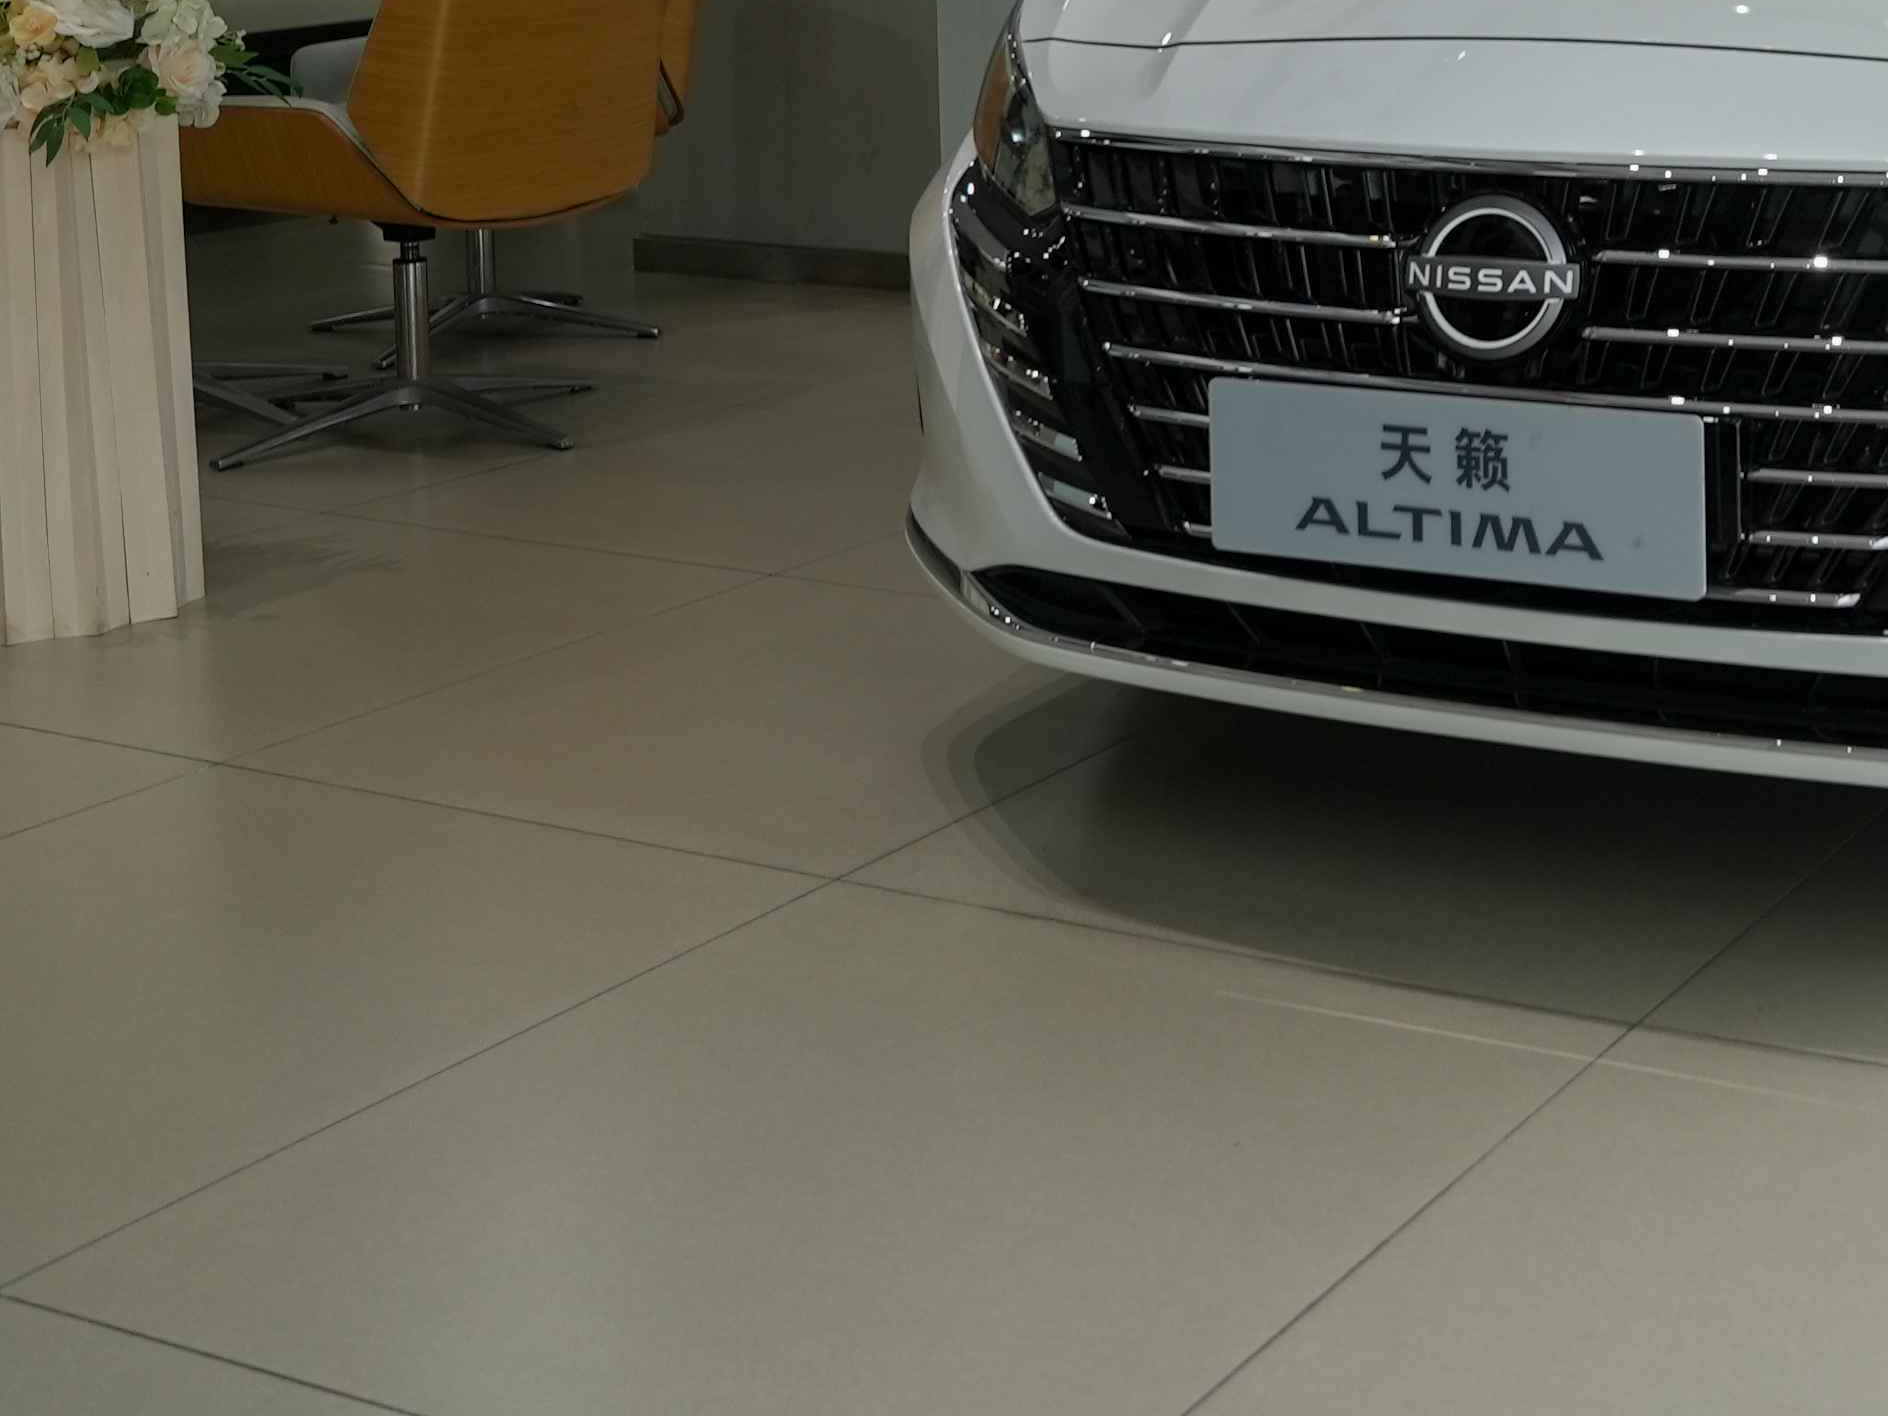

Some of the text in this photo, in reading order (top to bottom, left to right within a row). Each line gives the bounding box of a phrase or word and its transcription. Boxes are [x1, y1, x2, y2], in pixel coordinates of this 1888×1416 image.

[1408, 261, 1575, 295] NISSAN
[1380, 422, 1510, 492] 天籁
[1295, 495, 1605, 561] ALTIMA
